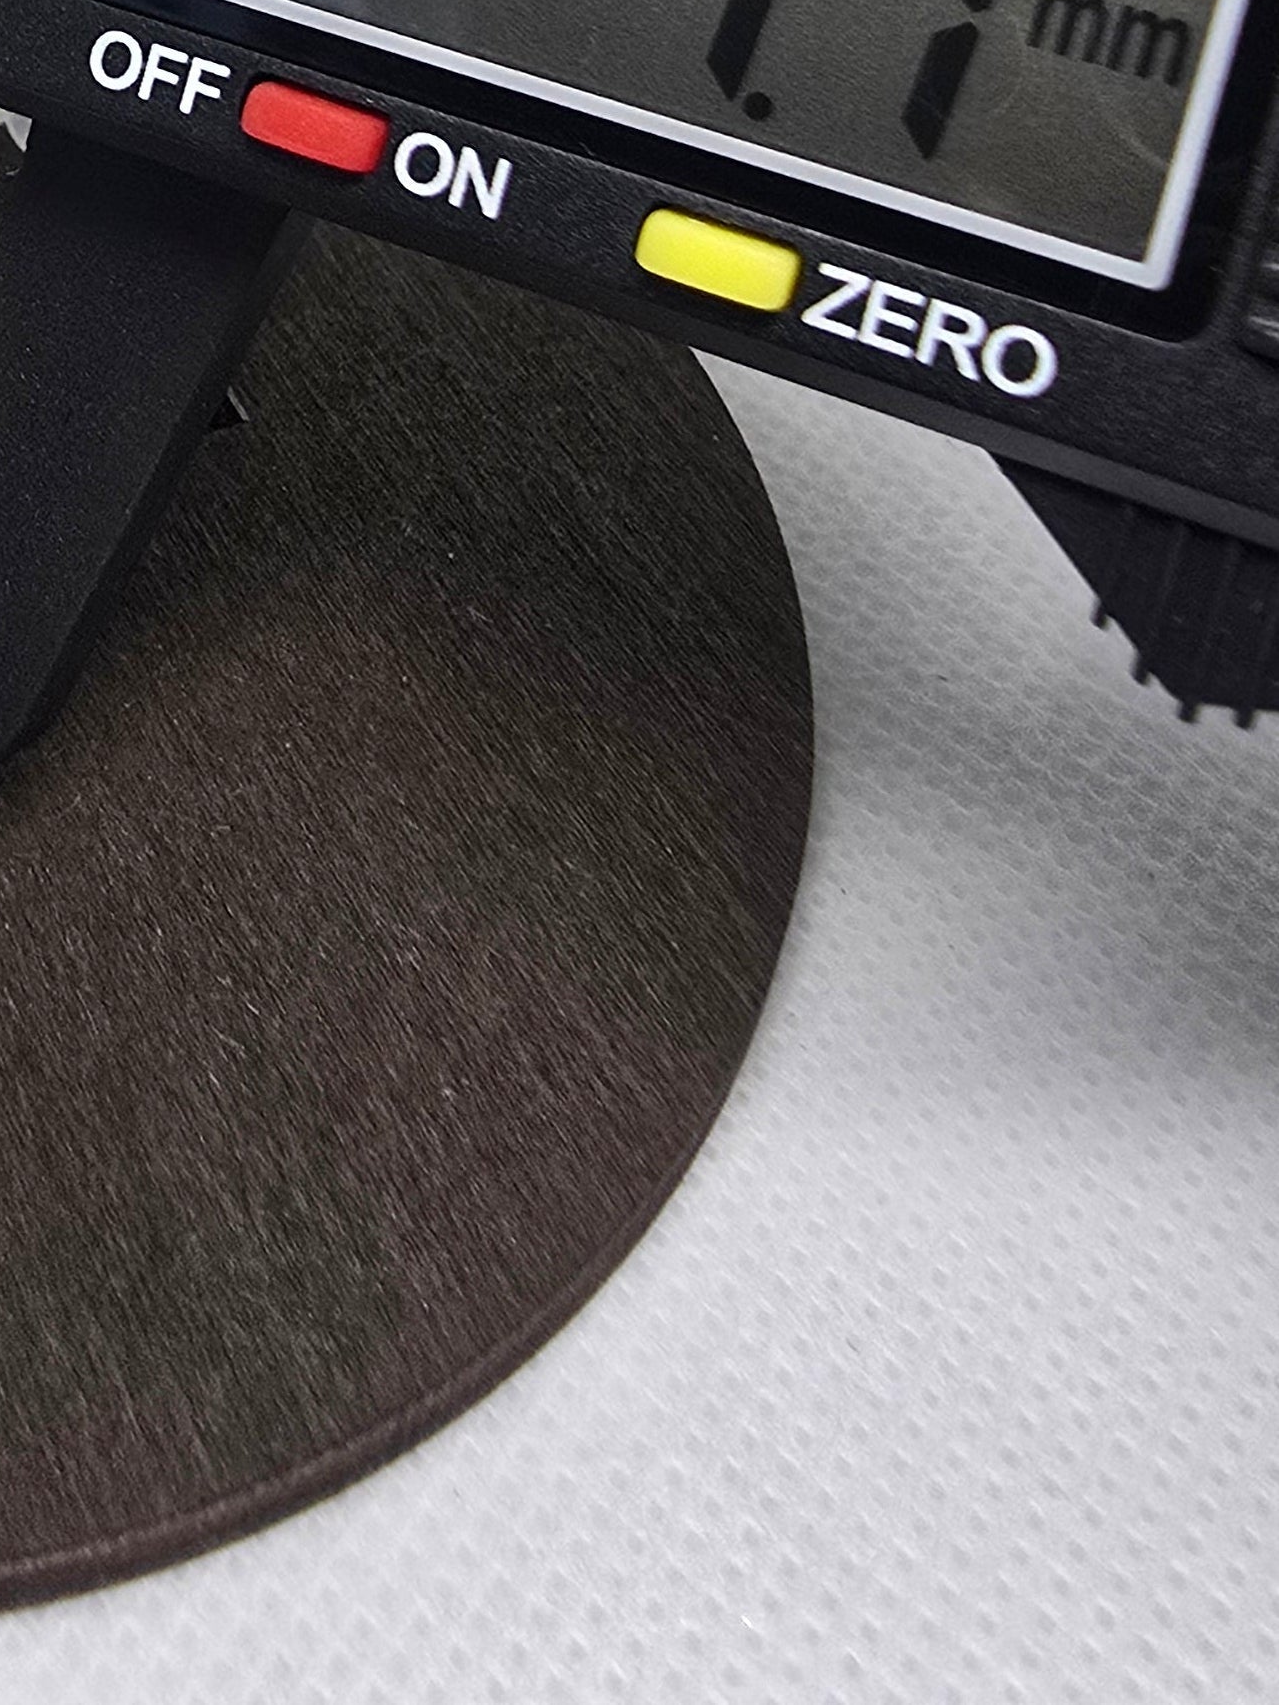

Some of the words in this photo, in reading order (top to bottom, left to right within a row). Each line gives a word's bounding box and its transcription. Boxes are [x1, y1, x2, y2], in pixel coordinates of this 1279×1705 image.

[89, 30, 231, 115] OFF
[393, 131, 513, 221] ON
[800, 261, 1058, 400] ZERO
